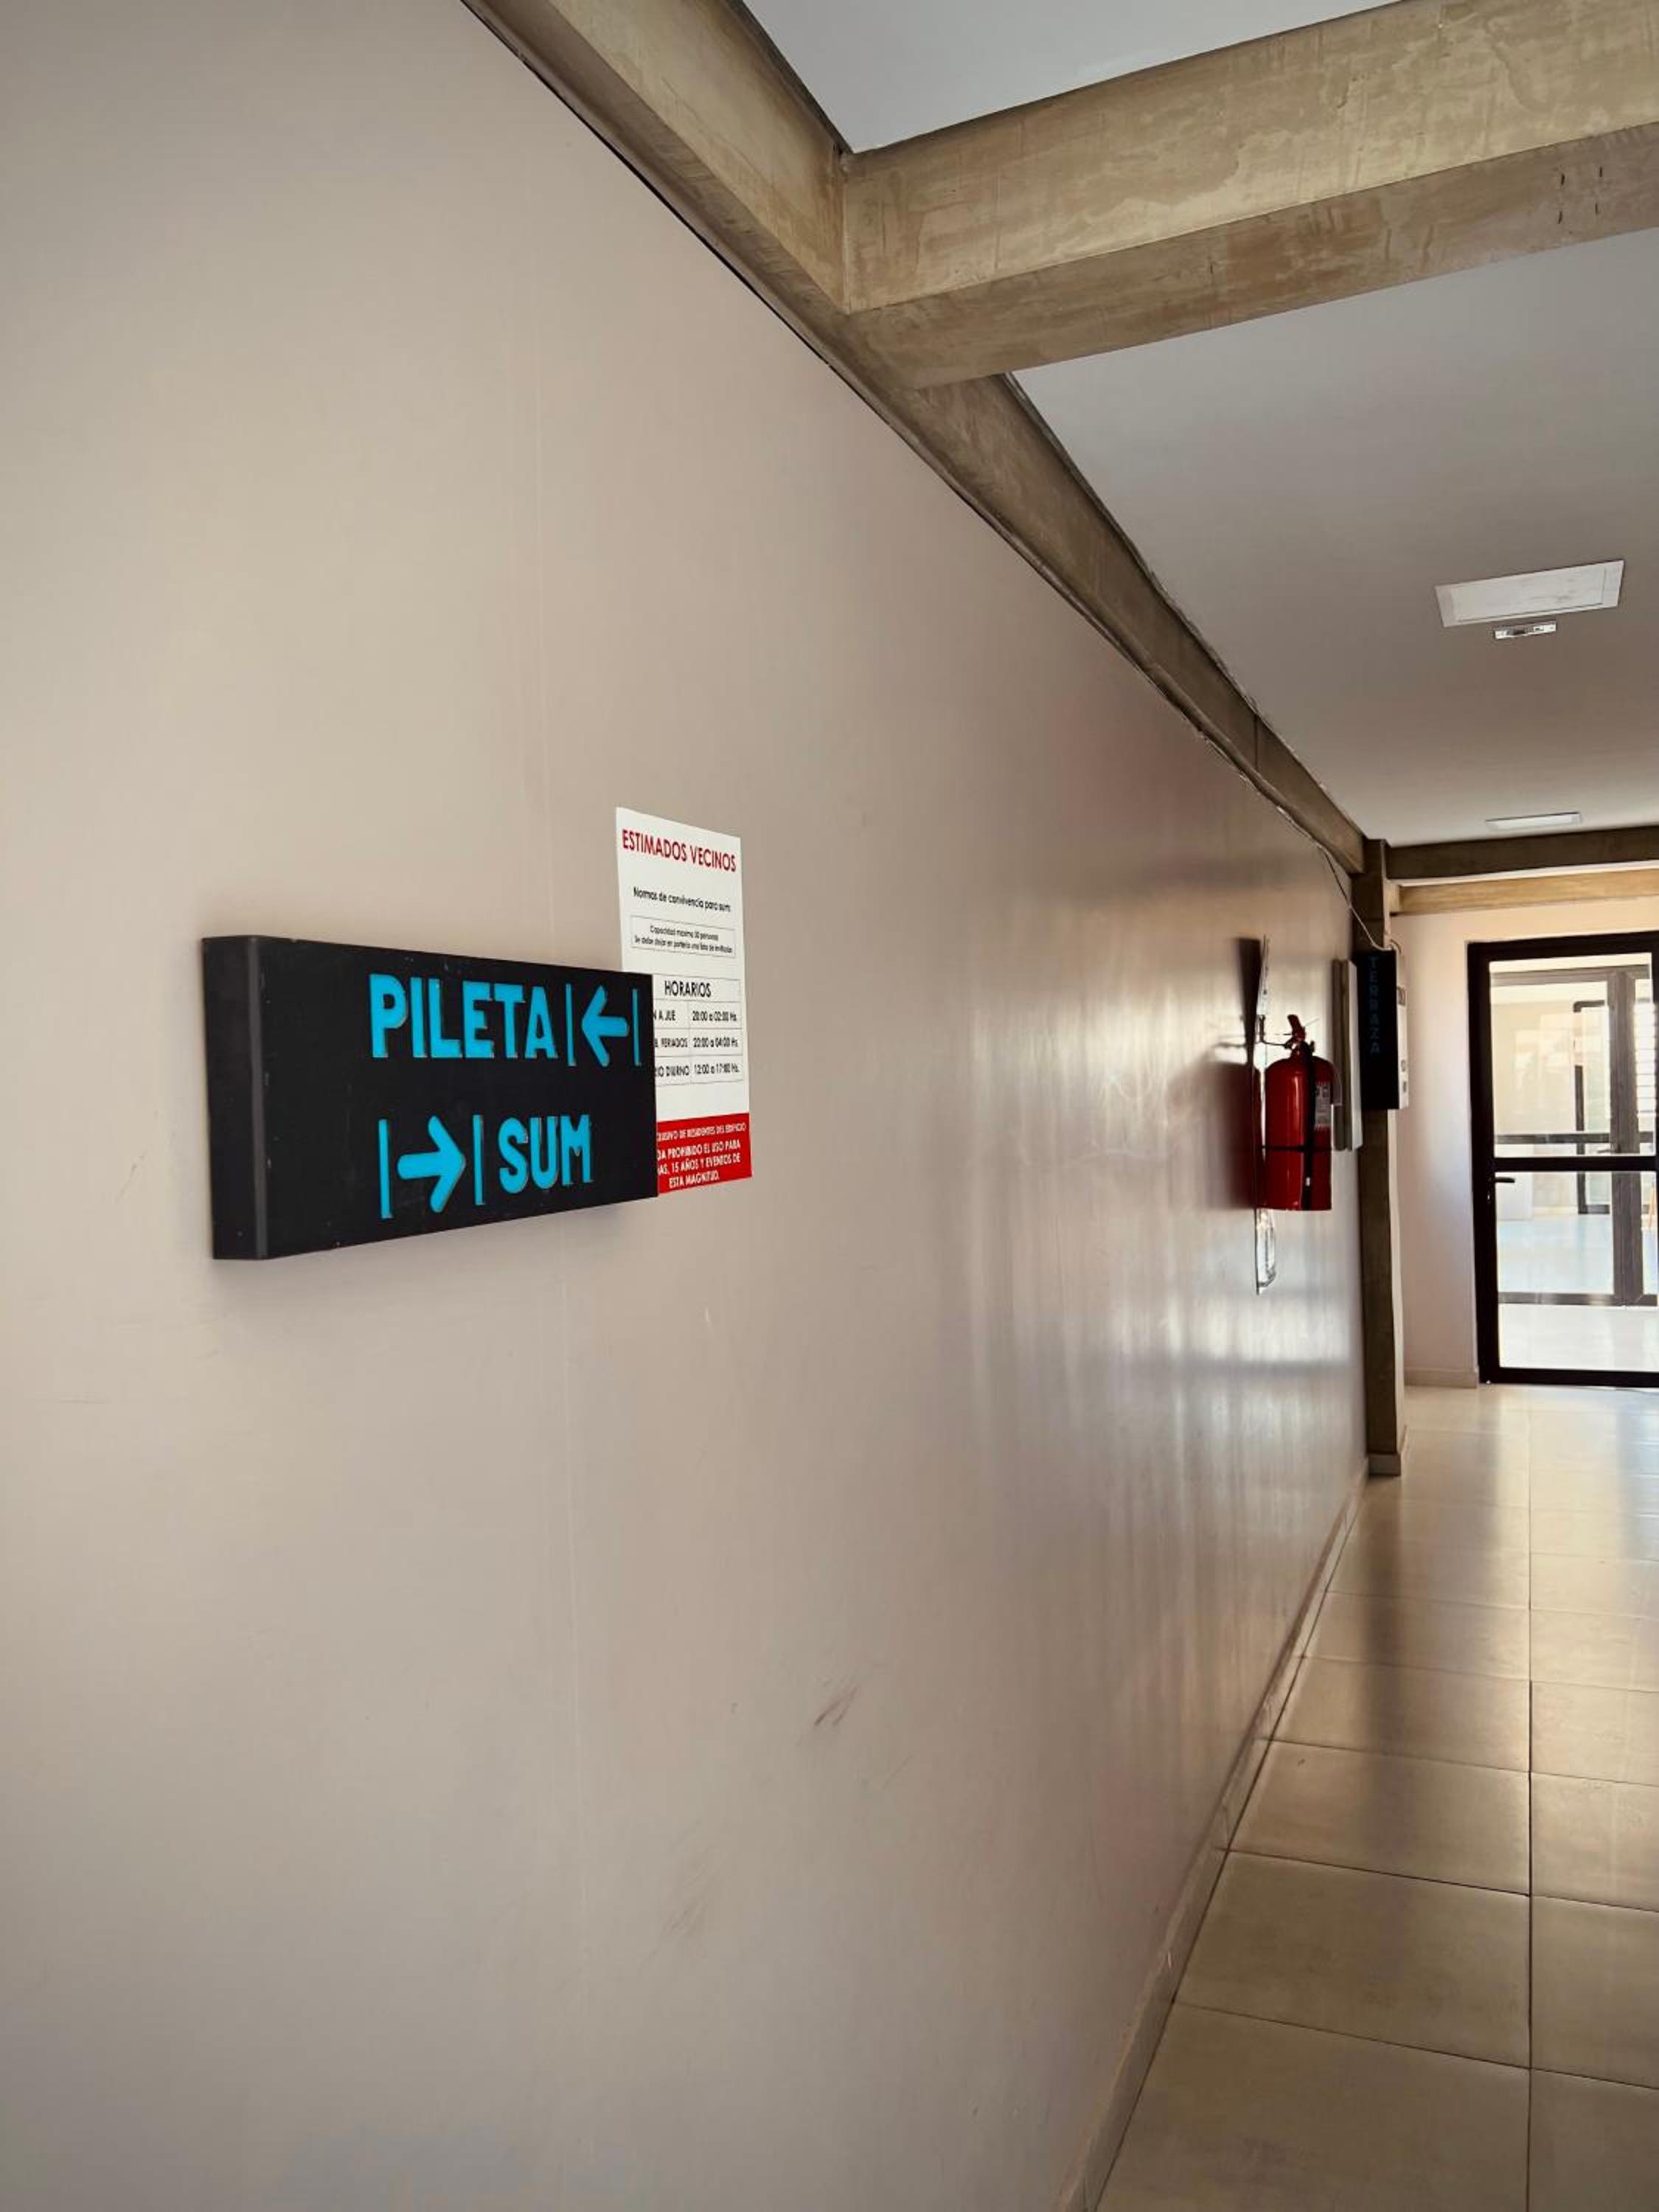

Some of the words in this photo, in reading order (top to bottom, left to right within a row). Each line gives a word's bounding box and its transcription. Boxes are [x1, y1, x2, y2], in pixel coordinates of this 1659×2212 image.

[622, 829, 687, 862] ESTIMADOS
[690, 846, 737, 872] VECINOS
[633, 886, 658, 900] Normas
[659, 891, 667, 902] de
[668, 894, 703, 908] convivencia
[705, 901, 717, 911] para
[664, 981, 712, 998] HORARIOS
[369, 973, 558, 1059] PILETA
[666, 1065, 689, 1077] DIURNO
[694, 1064, 709, 1074] 12:00
[498, 1114, 592, 1194] SUM
[667, 1144, 703, 1159] PROHIBIDO
[703, 1143, 710, 1154] EL
[712, 1141, 724, 1152] USO
[725, 1139, 741, 1150] PARA
[672, 1162, 679, 1173] 15
[681, 1158, 699, 1171] AÑOS
[700, 1158, 704, 1169] Y
[706, 1154, 732, 1167] EVENTOS
[733, 1152, 741, 1163] DE
[669, 1176, 684, 1189] ESTA
